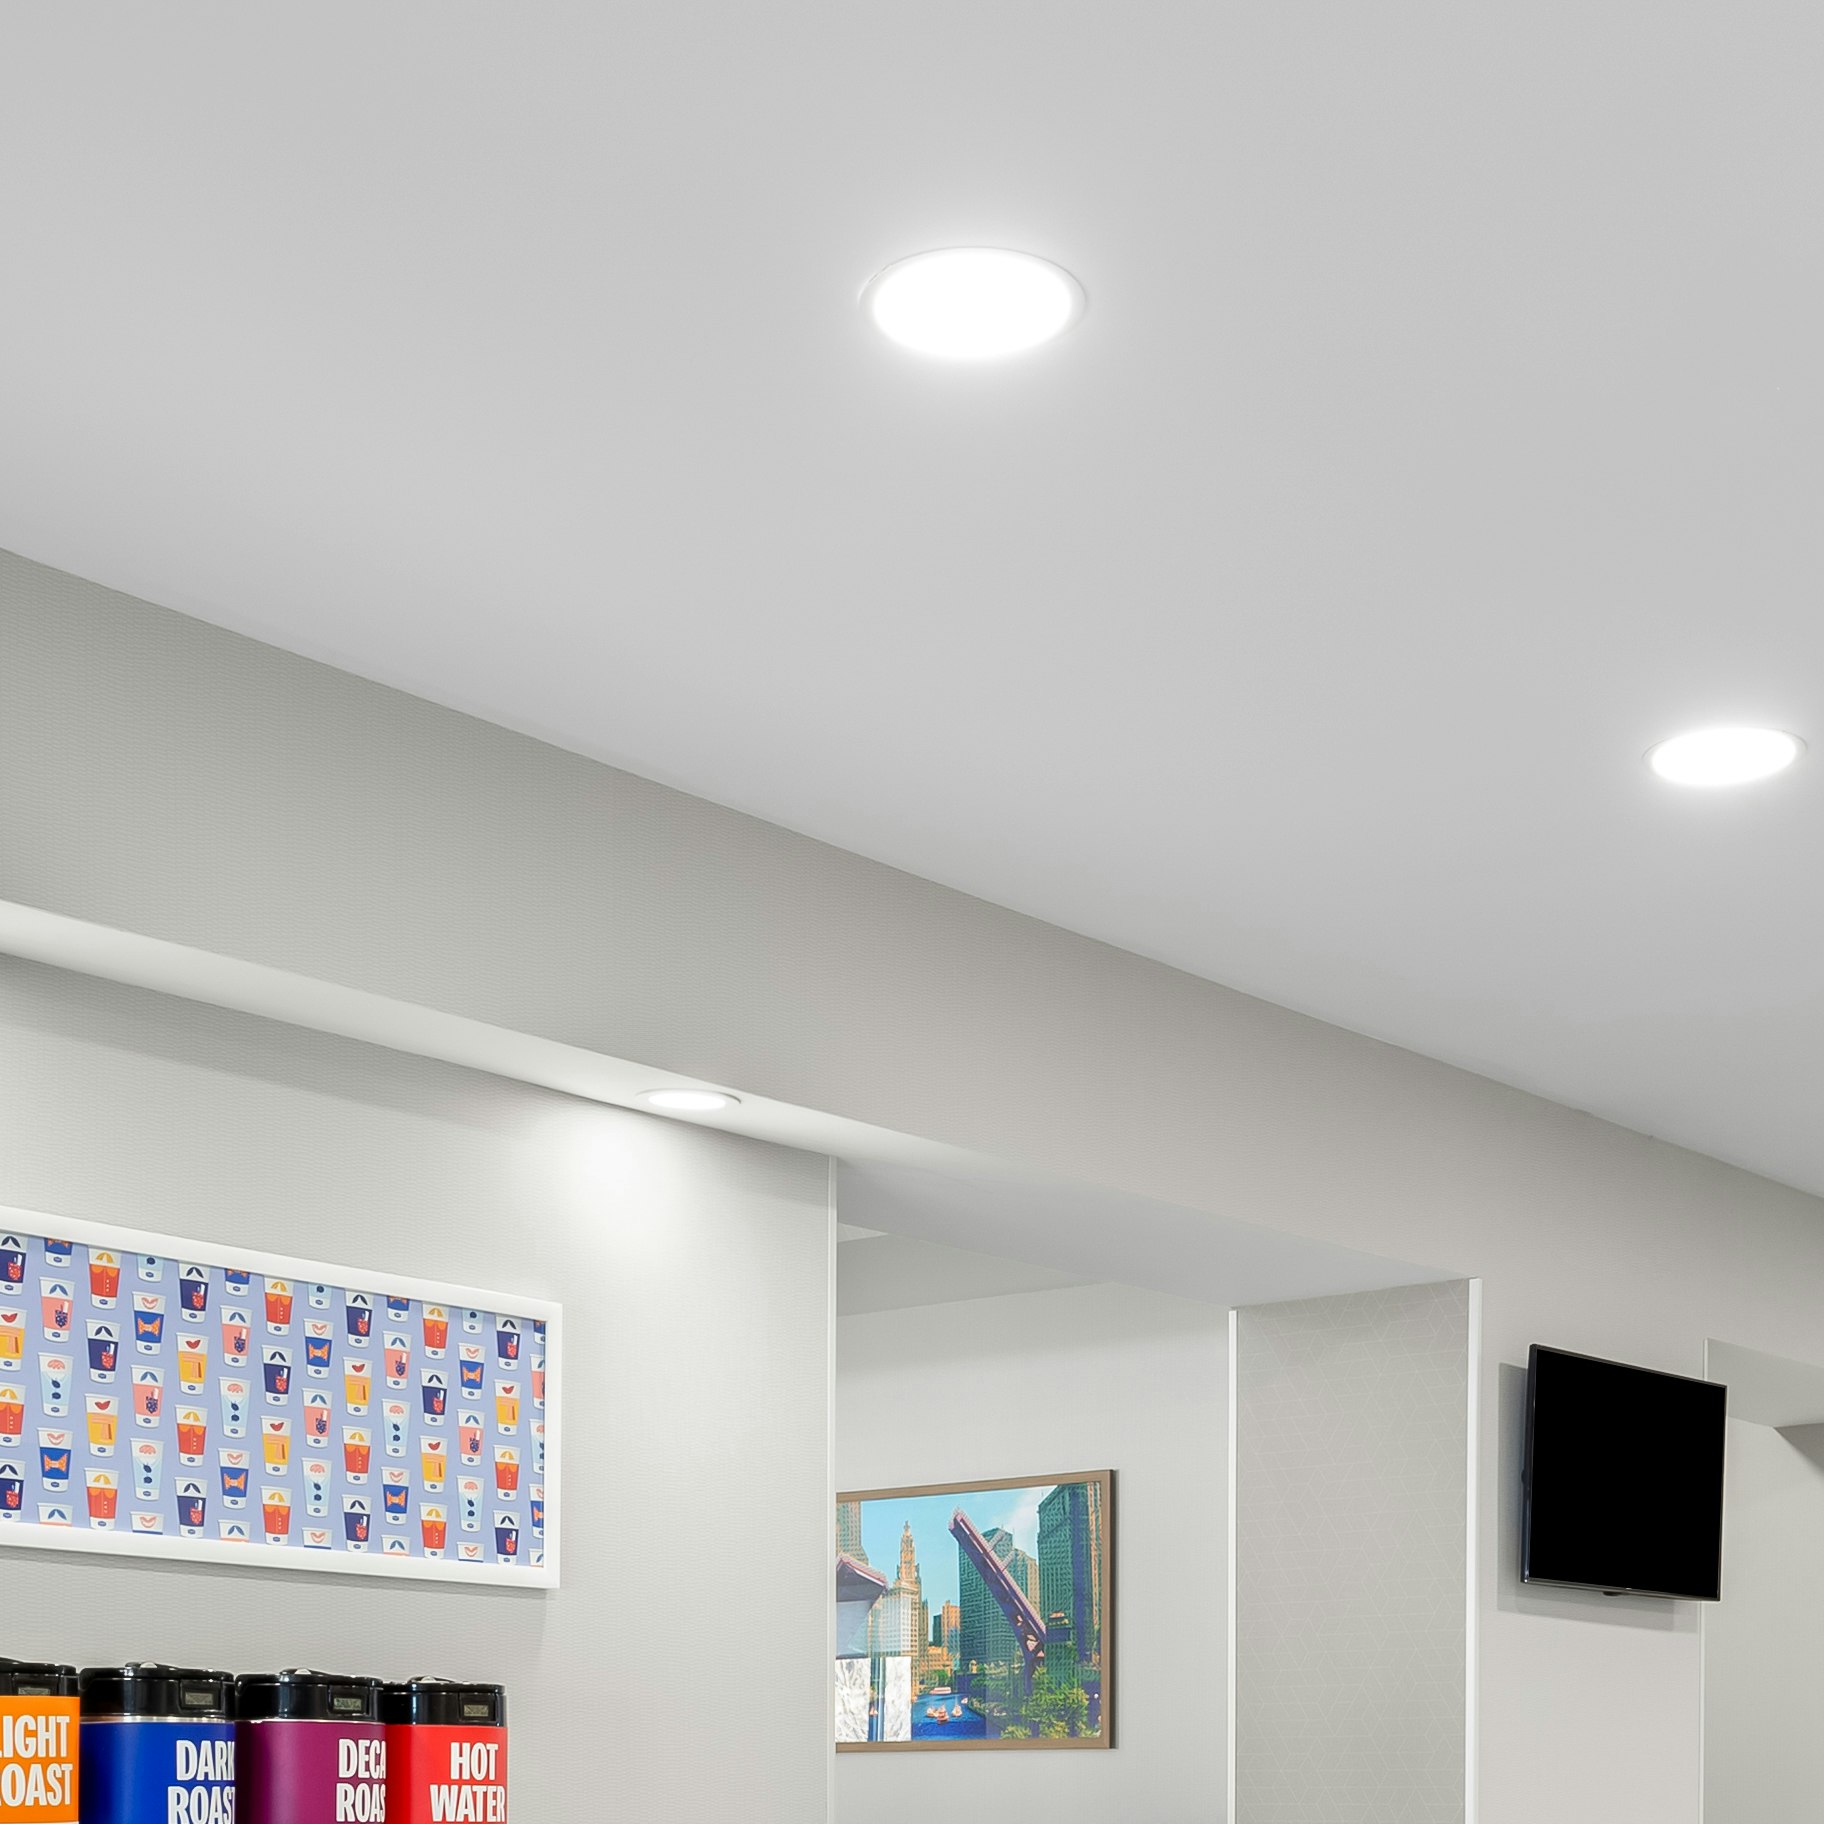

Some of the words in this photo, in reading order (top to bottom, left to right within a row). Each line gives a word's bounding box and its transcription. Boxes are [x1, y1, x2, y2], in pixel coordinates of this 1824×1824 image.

[176, 1739, 235, 1781] DARK
[450, 1742, 499, 1781] HOT
[429, 1784, 506, 1823] WATER
